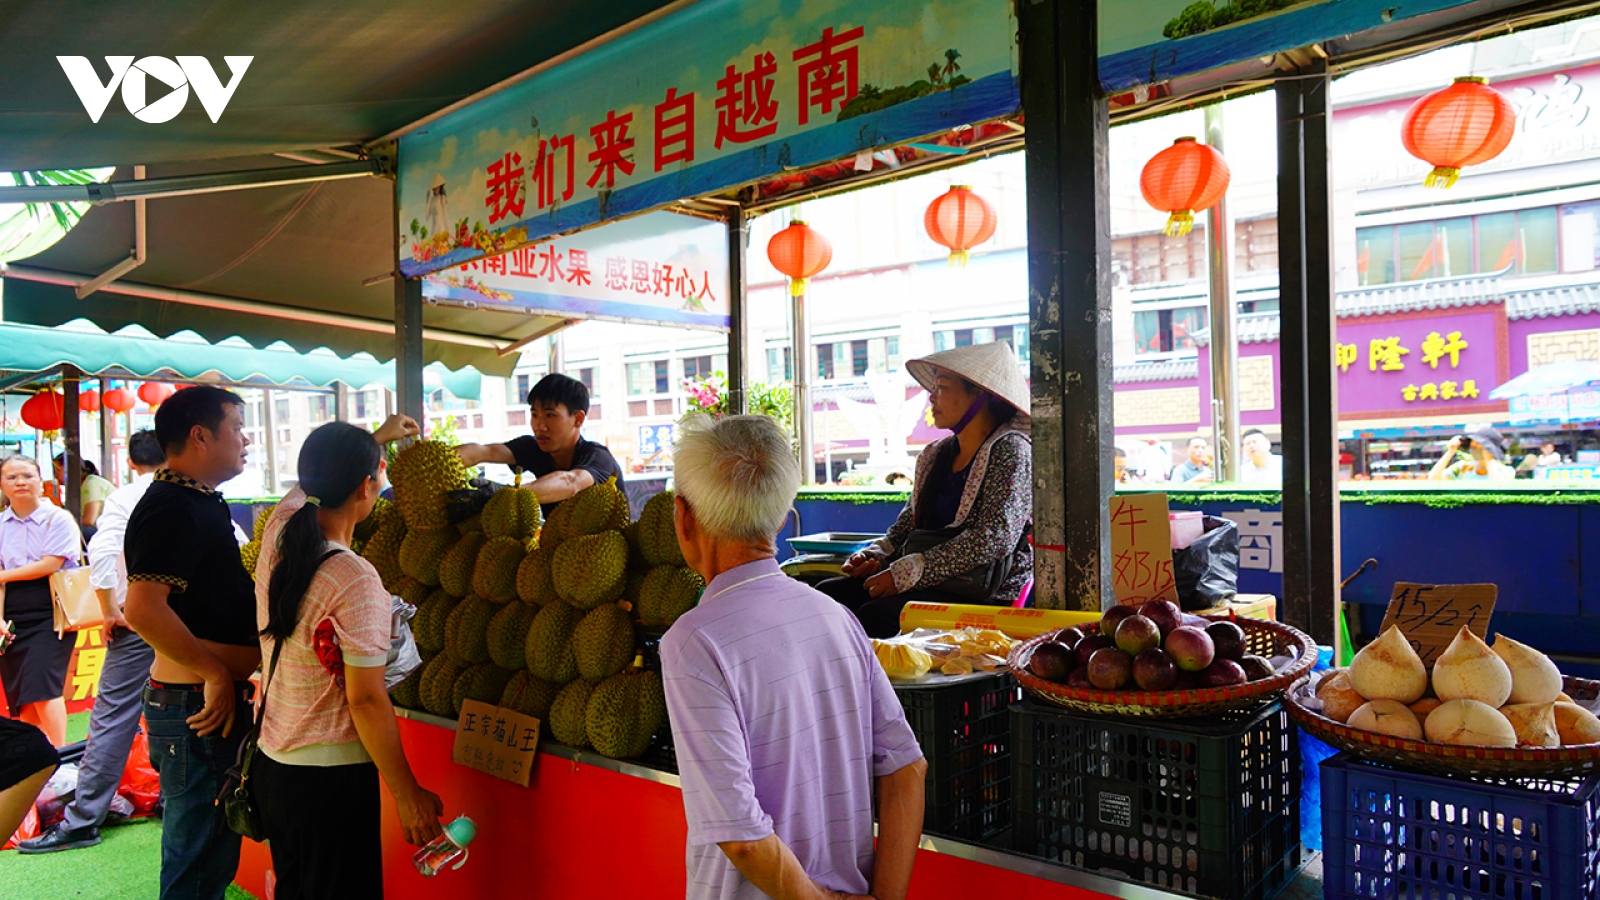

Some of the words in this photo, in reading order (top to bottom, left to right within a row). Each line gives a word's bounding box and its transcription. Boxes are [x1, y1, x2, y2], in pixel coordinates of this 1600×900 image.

[485, 25, 865, 226] 我们来自越南
[604, 255, 716, 303] 感恩好心人
[1400, 379, 1481, 402] 古典家具
